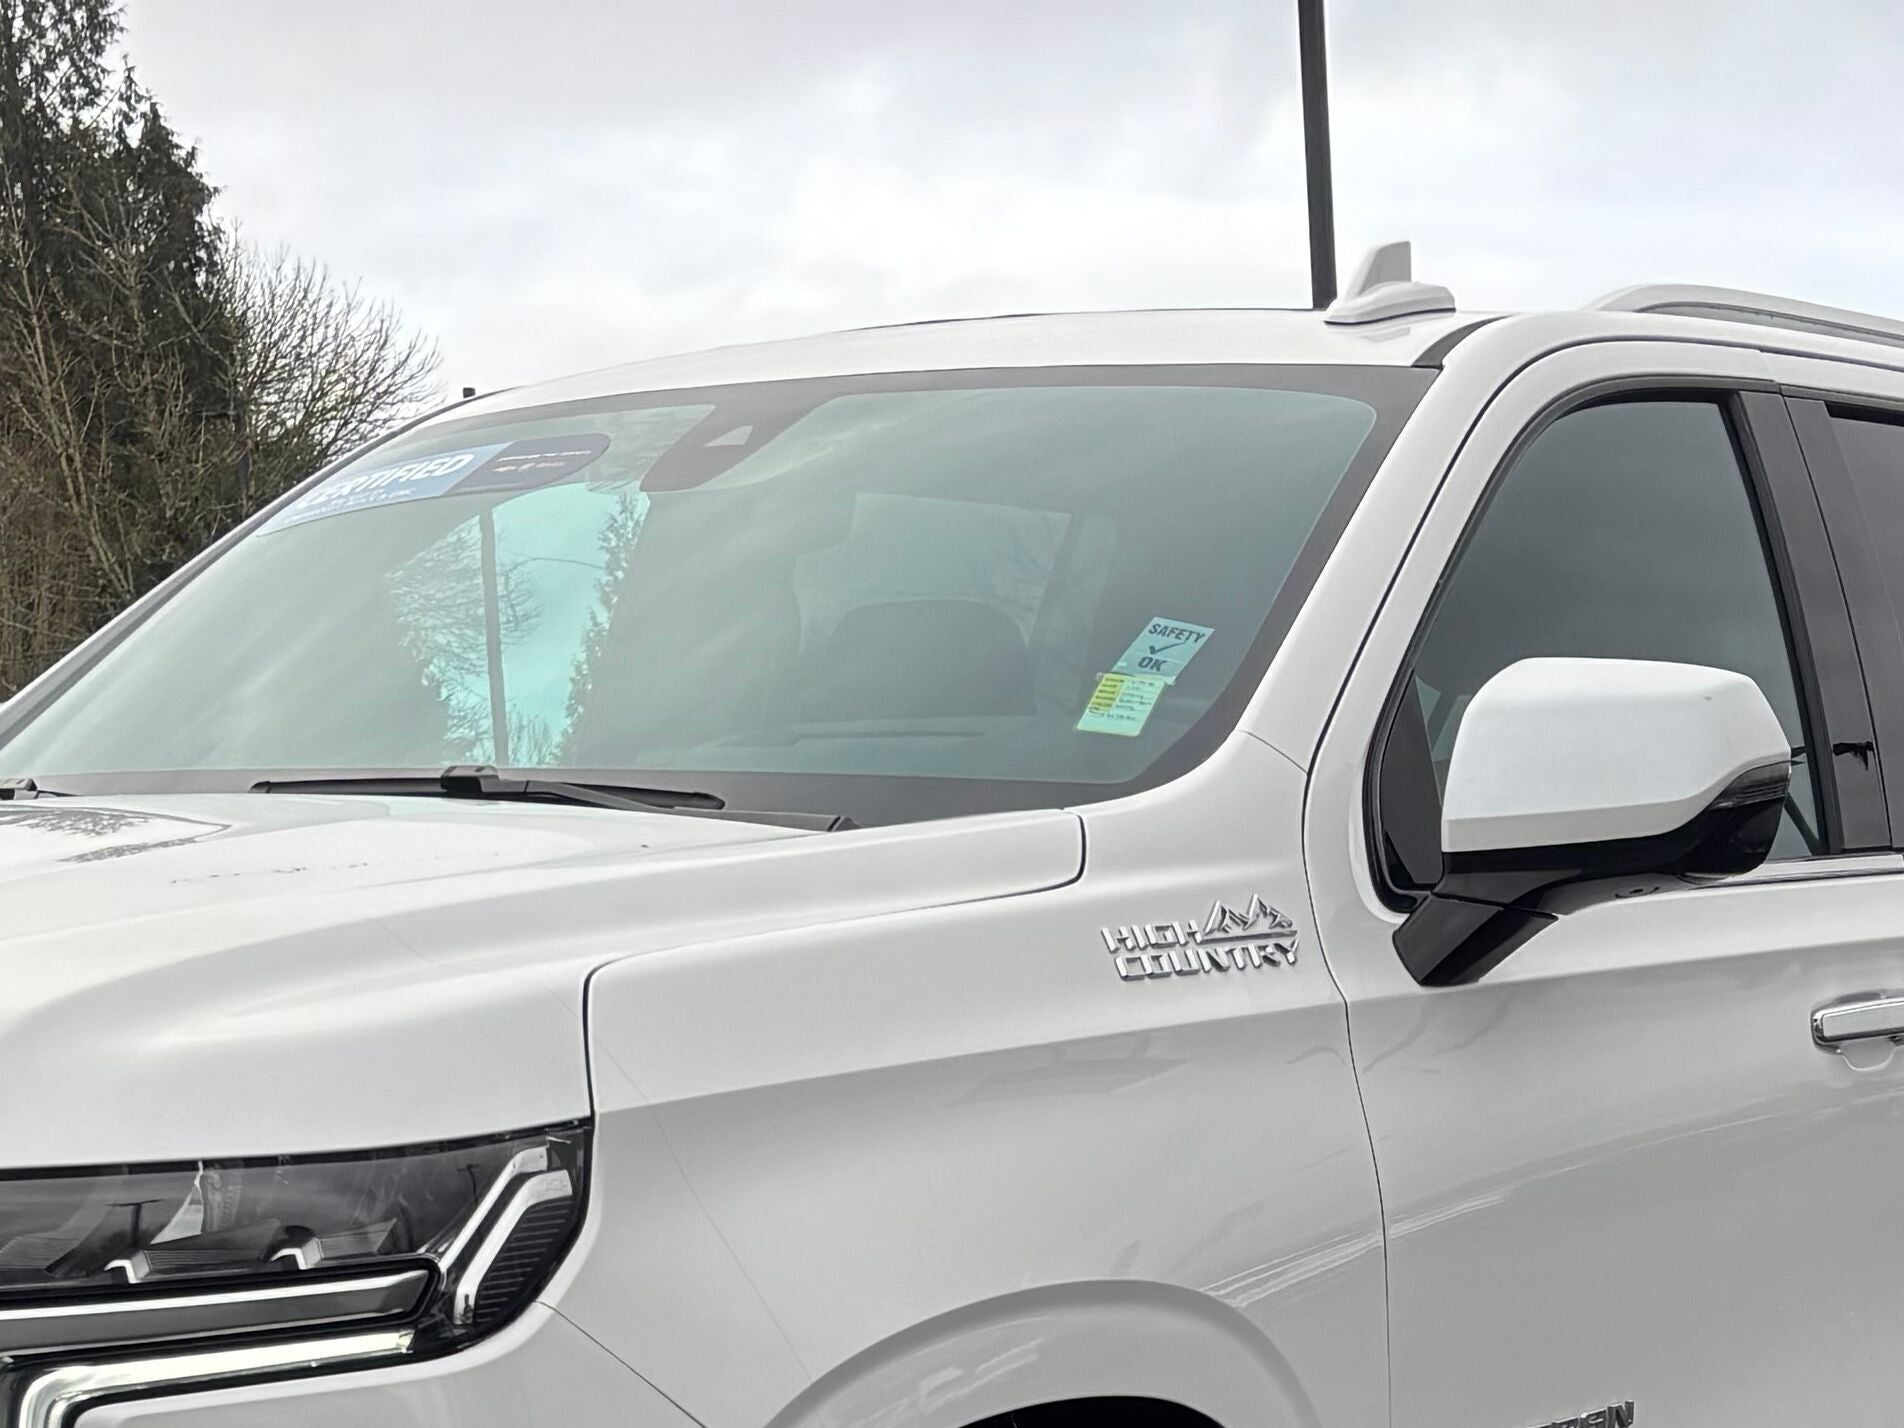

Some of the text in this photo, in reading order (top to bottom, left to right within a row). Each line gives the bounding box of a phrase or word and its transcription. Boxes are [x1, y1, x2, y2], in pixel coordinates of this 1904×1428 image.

[1148, 623, 1206, 643] SAFETY
[1138, 656, 1168, 672] OK
[1101, 919, 1204, 953] HIGH
[1114, 933, 1302, 982] COUNTRY
